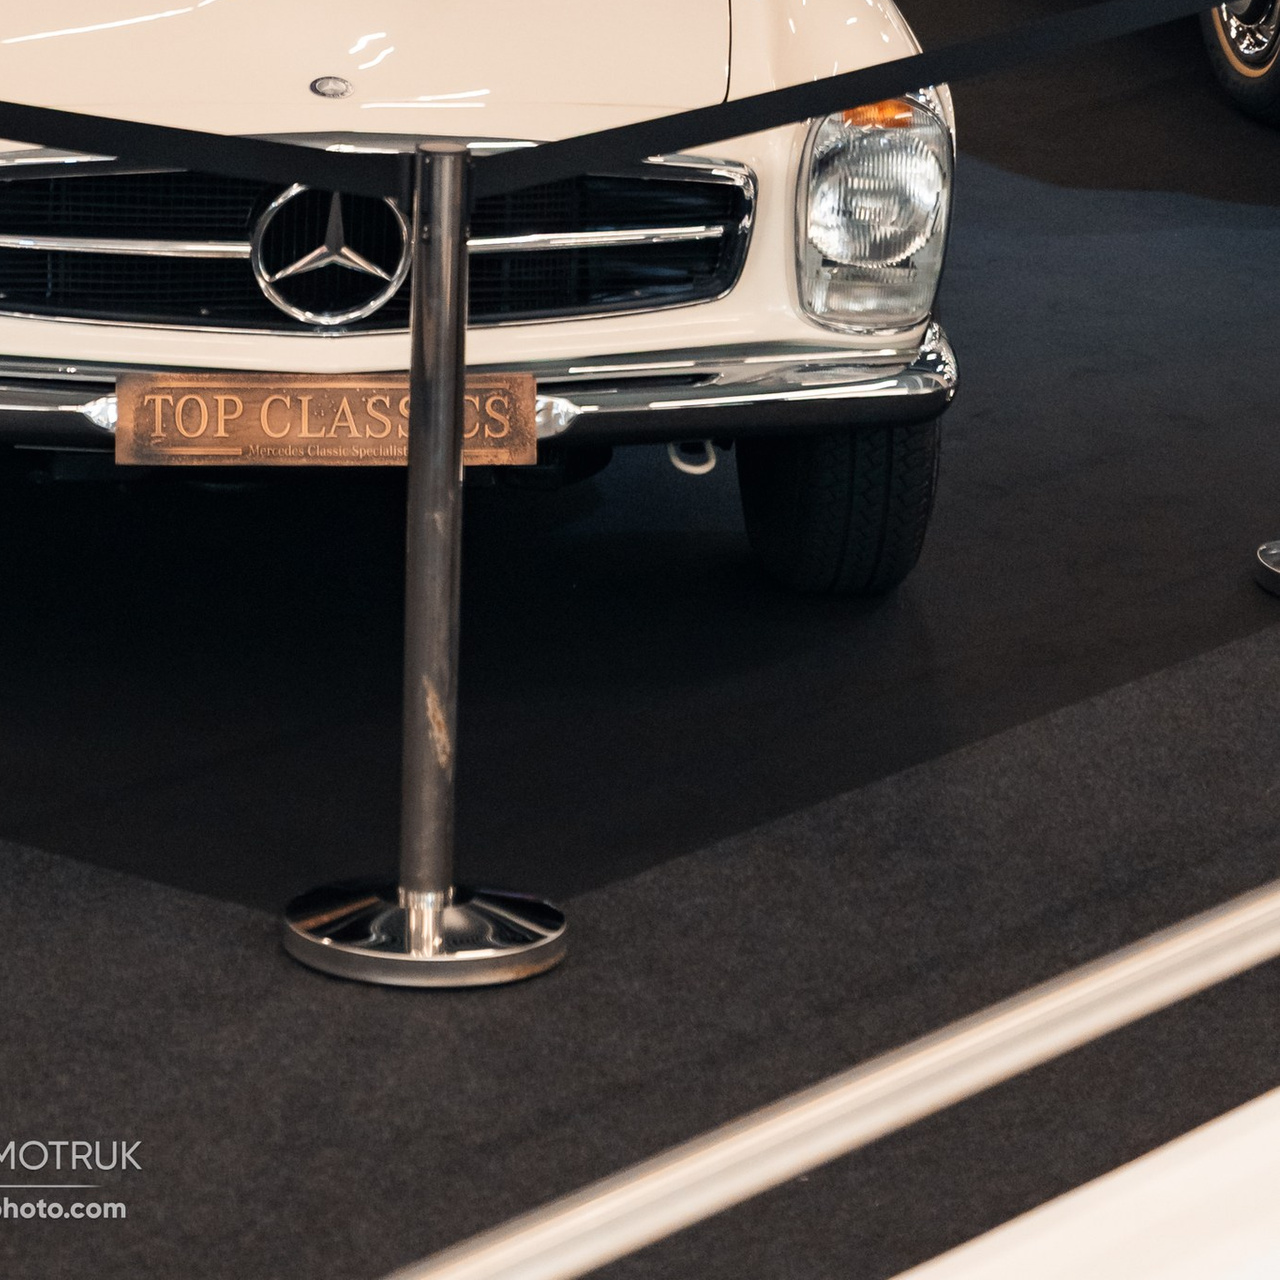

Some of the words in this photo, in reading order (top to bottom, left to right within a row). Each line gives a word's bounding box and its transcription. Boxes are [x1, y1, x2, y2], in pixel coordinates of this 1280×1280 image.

[144, 394, 244, 438] TOP
[260, 393, 510, 439] CLASCS
[248, 444, 304, 457] Mercedes
[307, 443, 350, 457] Classic
[352, 443, 408, 459] Specialist
